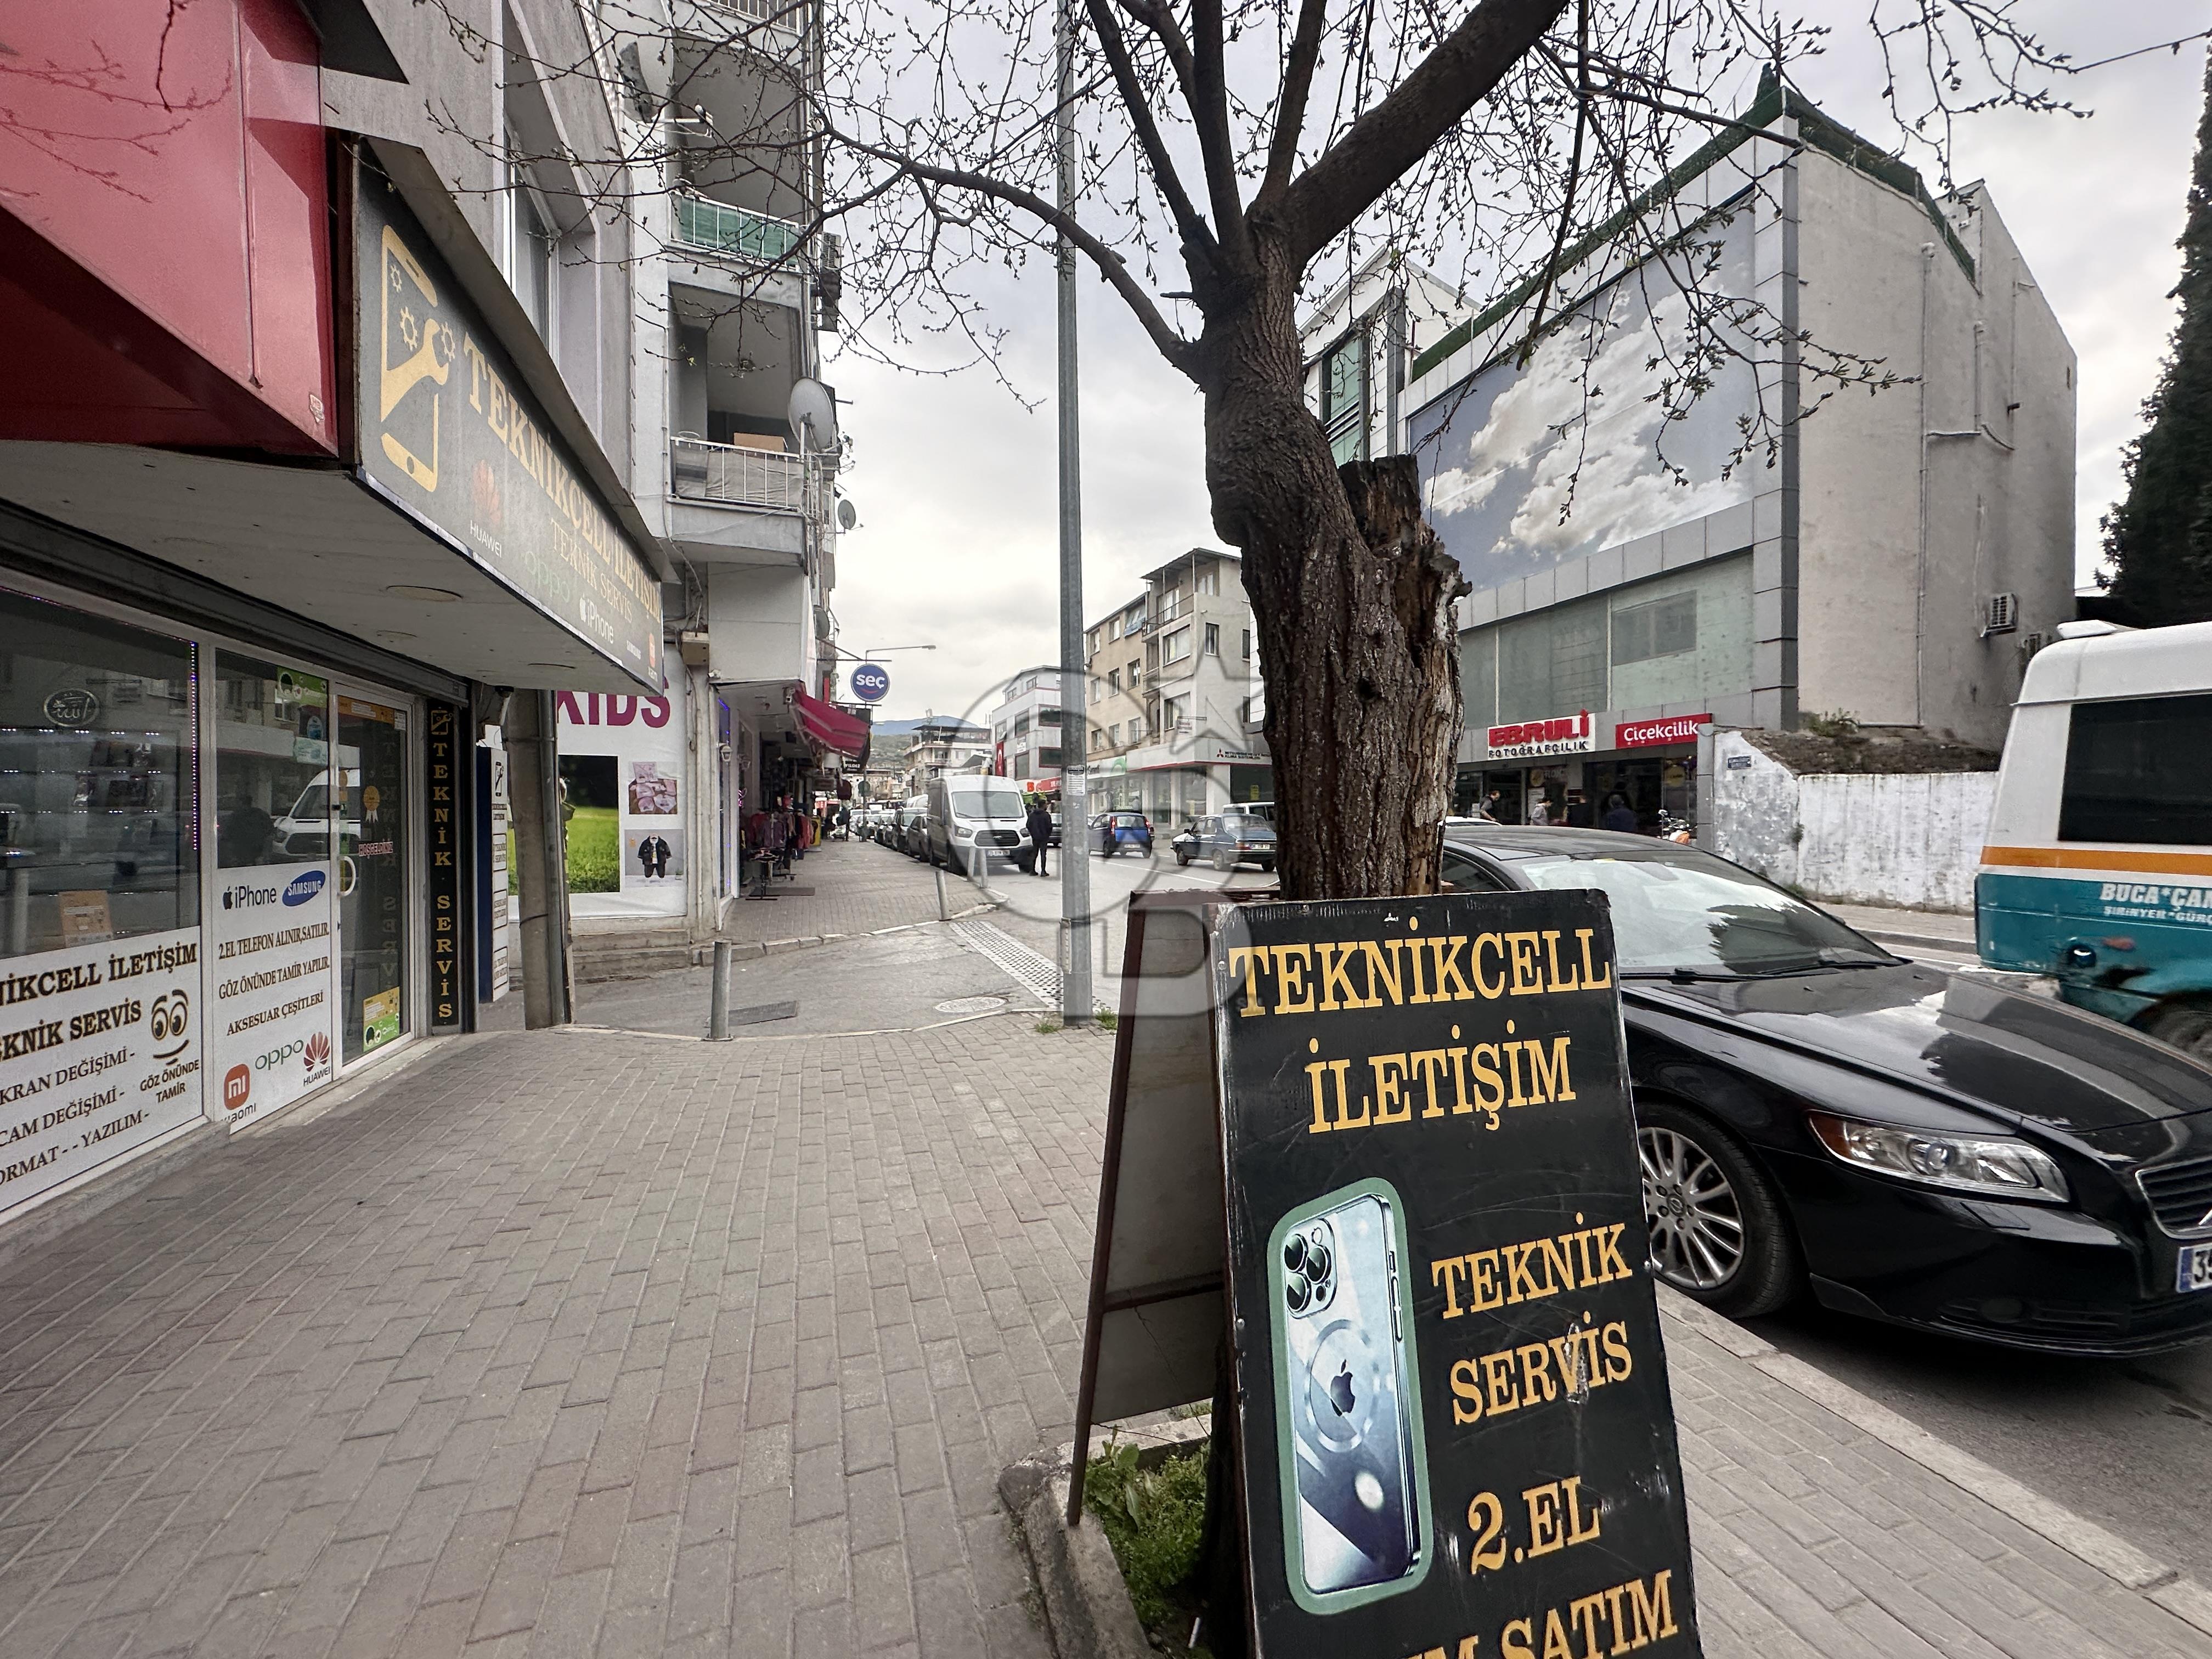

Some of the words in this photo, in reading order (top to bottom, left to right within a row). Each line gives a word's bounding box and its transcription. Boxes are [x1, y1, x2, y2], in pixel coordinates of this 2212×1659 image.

[464, 333, 610, 565] TEKNİKCELL
[614, 526, 660, 623] İLETİŞİM
[470, 520, 502, 558] HUAWEI
[524, 550, 570, 603] oppo
[550, 517, 597, 591] TEKNİK
[601, 573, 632, 623] SERVİS
[586, 596, 614, 645] iPhone
[856, 674, 885, 689] seç
[1488, 709, 1589, 747] EBRULİ
[1624, 720, 1699, 745] Çiçekçilik
[1488, 741, 1589, 759] FOTOĞRAFÇILIK
[433, 742, 452, 866] TEKNİK
[235, 885, 276, 909] iPhone
[287, 879, 321, 896] SAMSUNG
[2100, 883, 2159, 905] BUCA
[219, 940, 236, 960] 2.EL
[238, 933, 274, 956] TELEFON
[436, 895, 453, 1018] SERVİS
[0, 963, 103, 1007] İKCELL
[108, 941, 198, 982] İLETİŞİM
[219, 979, 238, 1000] GÖZ
[240, 970, 276, 994] ÖNÜNDE
[277, 961, 302, 983] TAMİR
[1228, 916, 1612, 1018] TEKNİKCELL
[0, 1019, 64, 1062] KNİK
[70, 997, 142, 1041] SERVİS
[227, 1007, 280, 1036] AKSESUAR
[281, 989, 324, 1019] ÇEŞİTLERİ
[55, 1046, 127, 1086] DEĞİŞİMİ
[255, 1040, 304, 1070] oppo
[140, 1075, 160, 1092] GÖZ
[162, 1059, 200, 1083] ÖNÜNDE
[156, 1081, 186, 1103] TAMİR
[303, 1066, 330, 1087] HUAWEI
[1304, 1019, 1576, 1133] İLETİŞİM
[42, 1085, 117, 1130] DEĞİŞİMİ
[220, 1103, 256, 1124] aomi
[81, 1109, 143, 1148] YAZILIM
[1431, 1212, 1633, 1319] TEKNİK
[1450, 1310, 1632, 1425] SERVİS
[1467, 1475, 1601, 1576] 2.EL
[1502, 1569, 1679, 1659] SATIM
